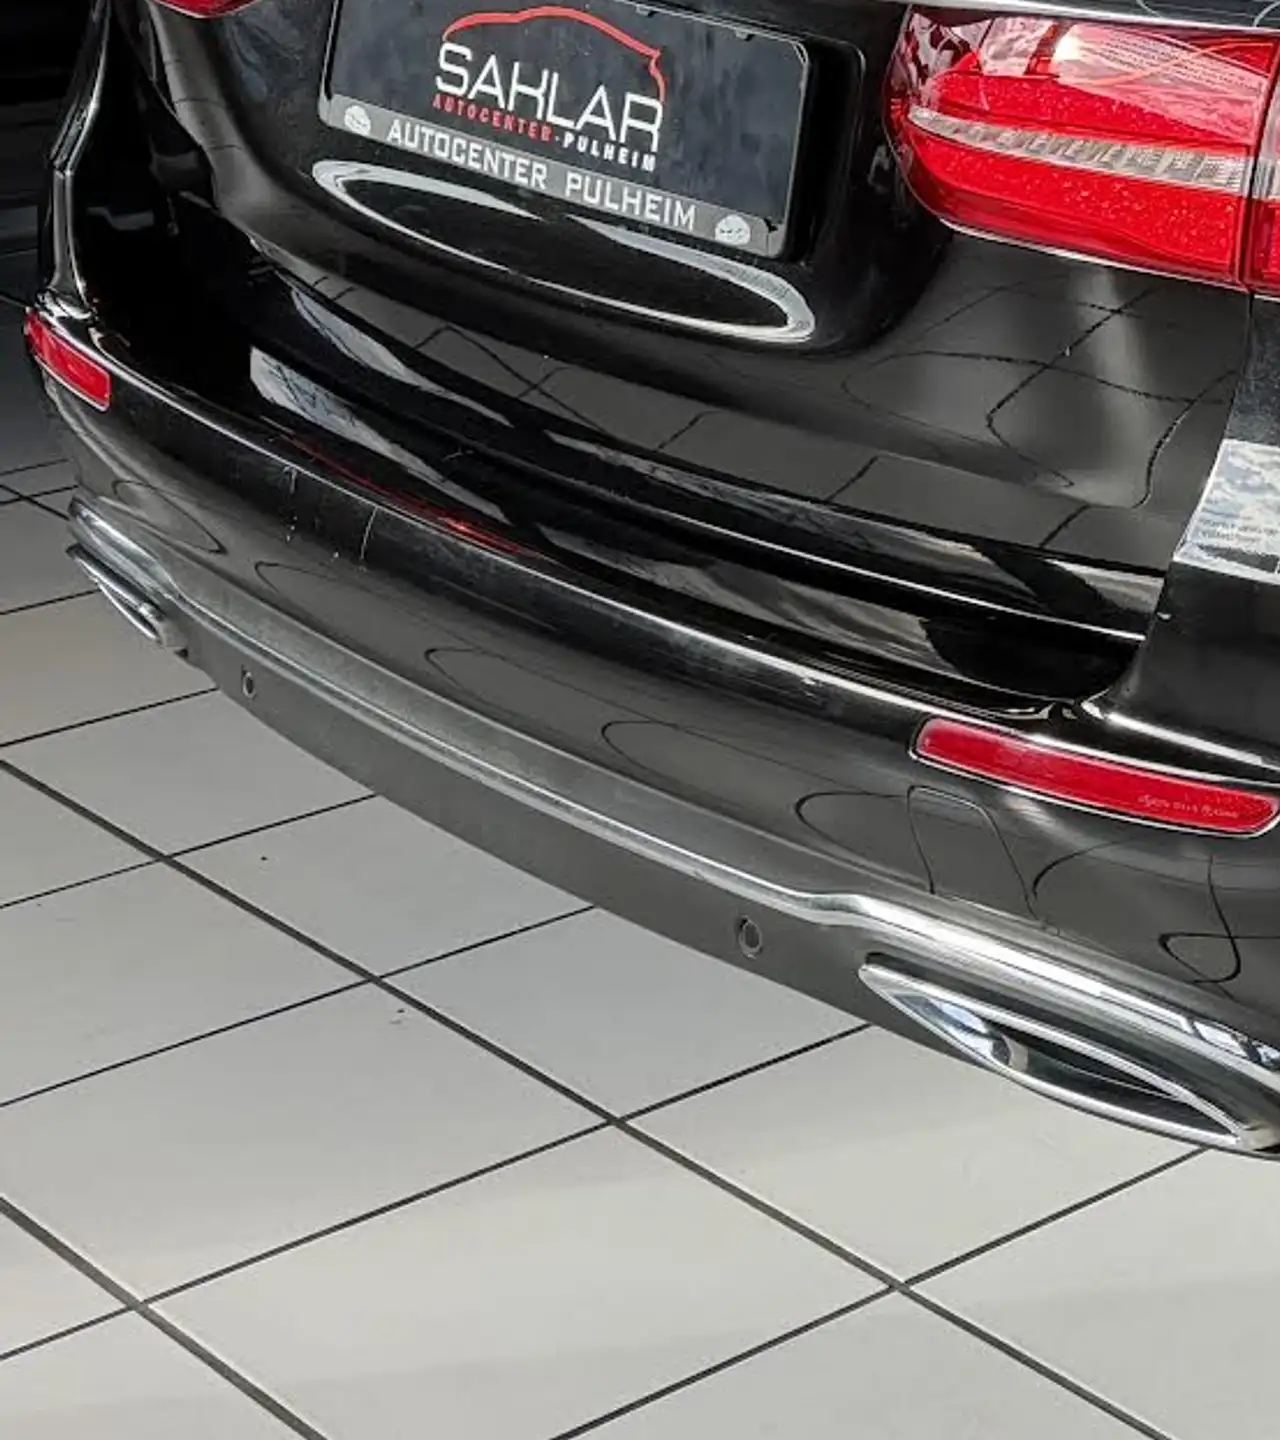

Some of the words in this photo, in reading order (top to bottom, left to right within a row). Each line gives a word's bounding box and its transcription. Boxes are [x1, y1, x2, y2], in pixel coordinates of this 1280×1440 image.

[435, 42, 664, 154] SAHLAR
[386, 119, 548, 191] AUTOCENTER
[565, 172, 698, 231] PULHEIM
